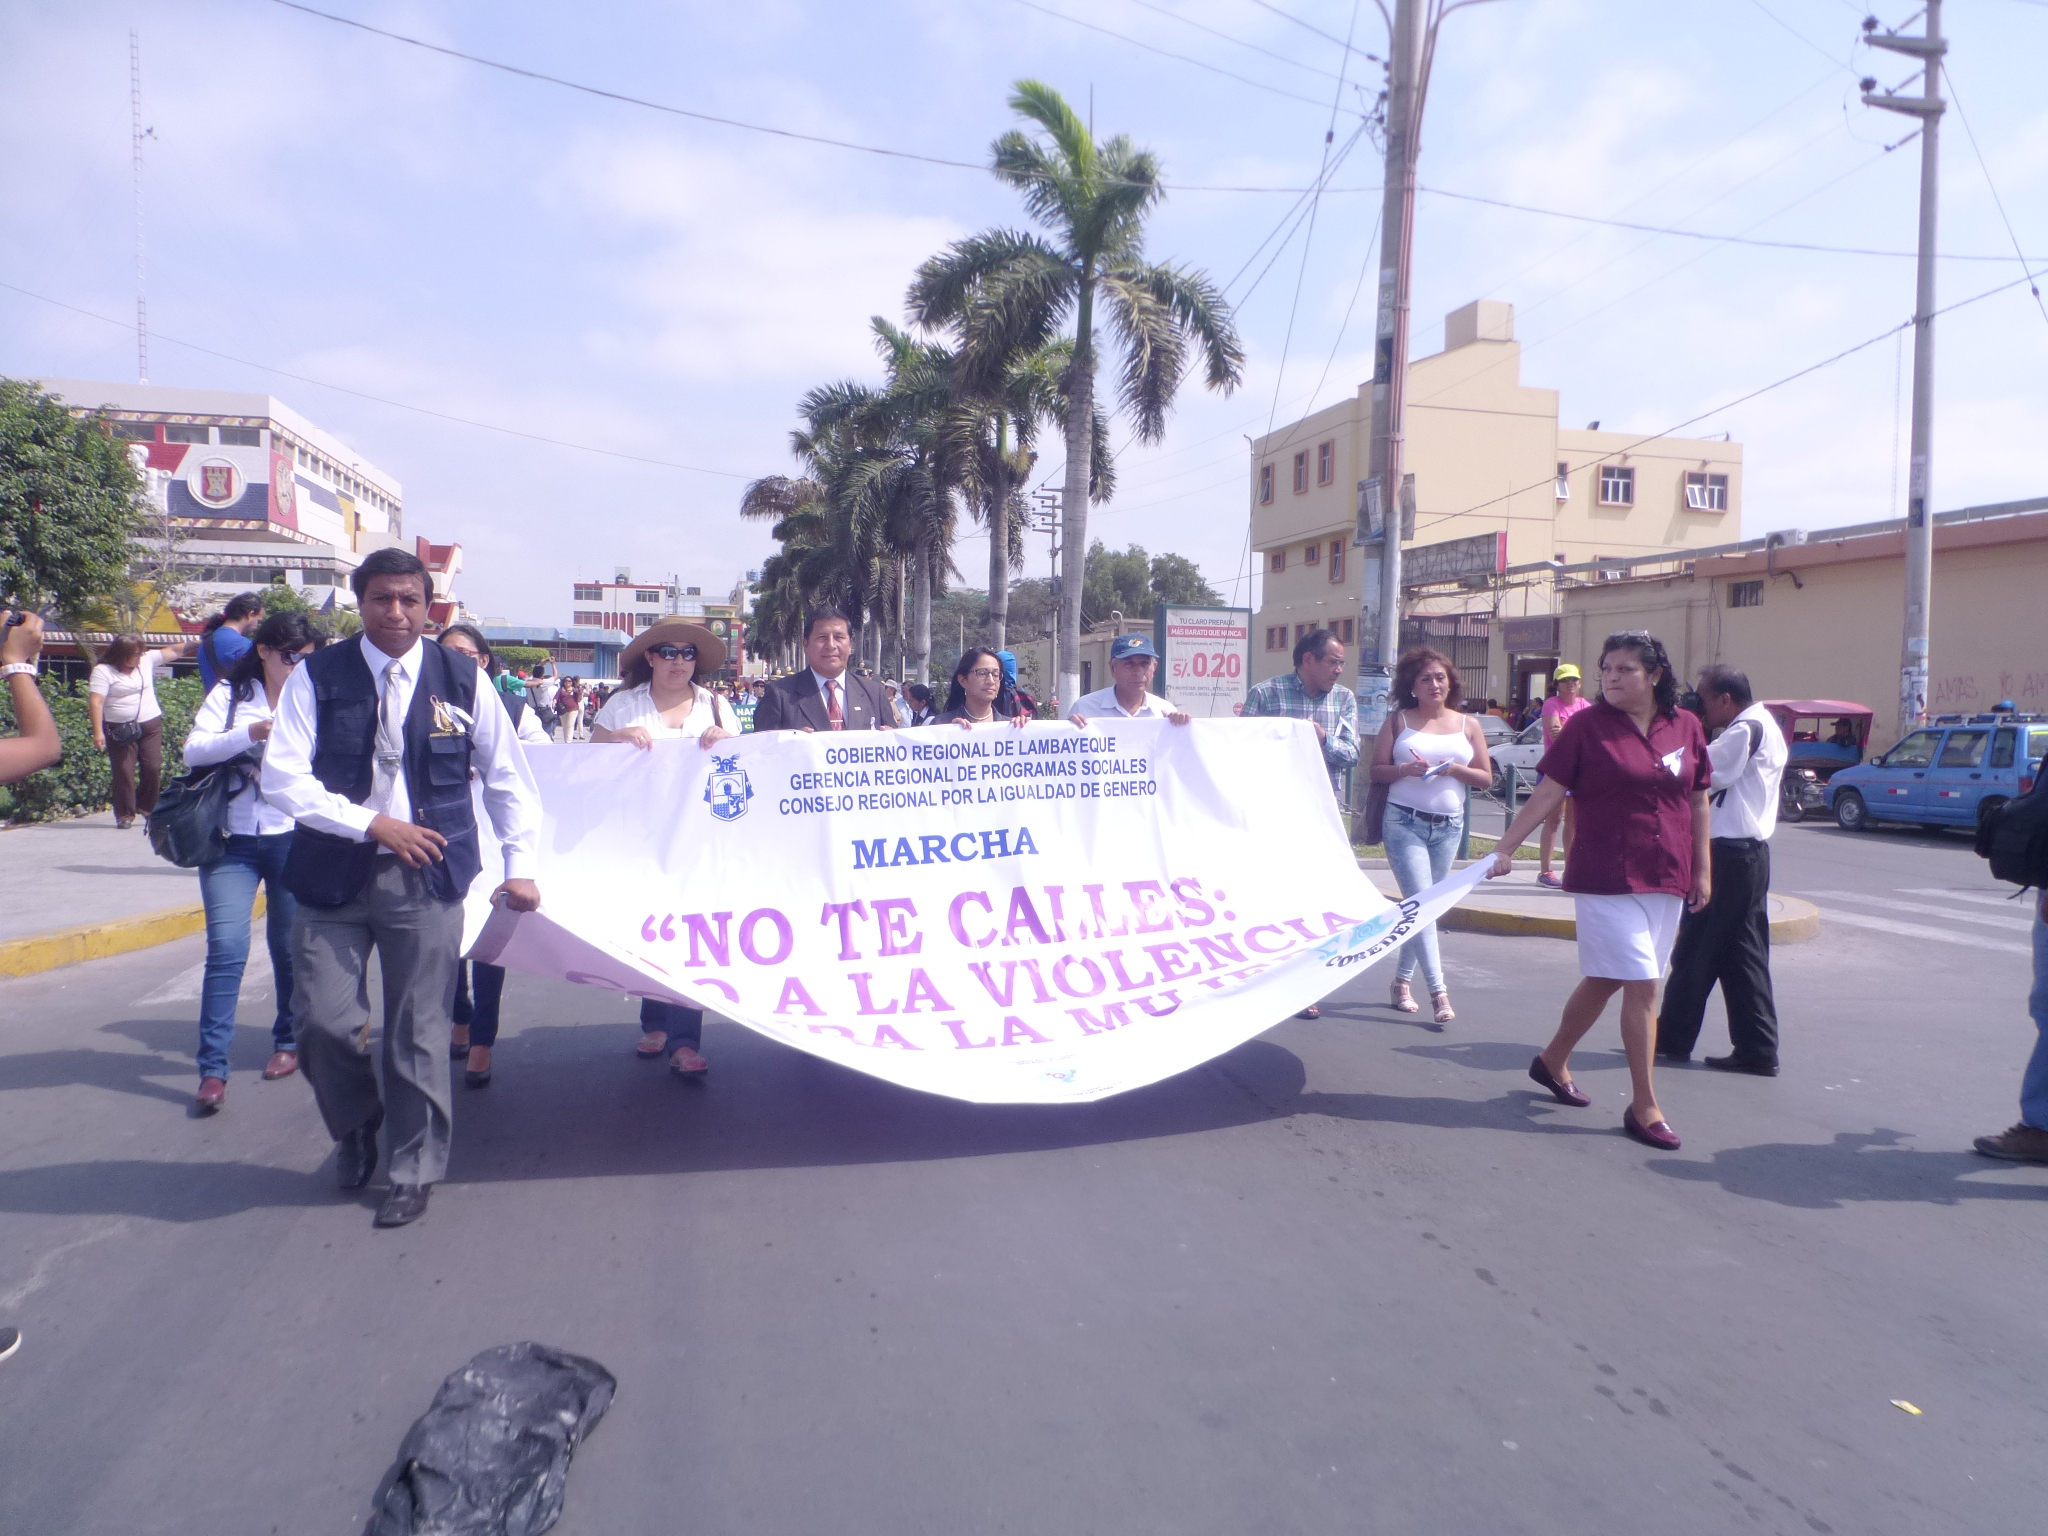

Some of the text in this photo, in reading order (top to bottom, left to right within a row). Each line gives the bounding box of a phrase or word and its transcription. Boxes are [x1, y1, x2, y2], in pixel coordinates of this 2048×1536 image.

[1171, 627, 1184, 635] MÁS
[1192, 652, 1241, 678] 0.20
[826, 737, 1116, 765] GOBIERNO REGIONAL DE LAMBAYEQUE
[790, 758, 1147, 790] GERENCIA REGIONAL DE PROGRAMAS SOCIALES
[779, 780, 1157, 815] CONSEJO REGIONAL POR LA IGUALDAD DE GENERO
[851, 827, 1039, 870] MARCHA
[820, 897, 923, 961] TE
[948, 876, 1236, 949] CALLES:
[773, 977, 828, 1016] A
[847, 967, 956, 1016] LA
[968, 911, 1364, 1007] VIOLENCIA
[940, 1016, 1055, 1050] LA
